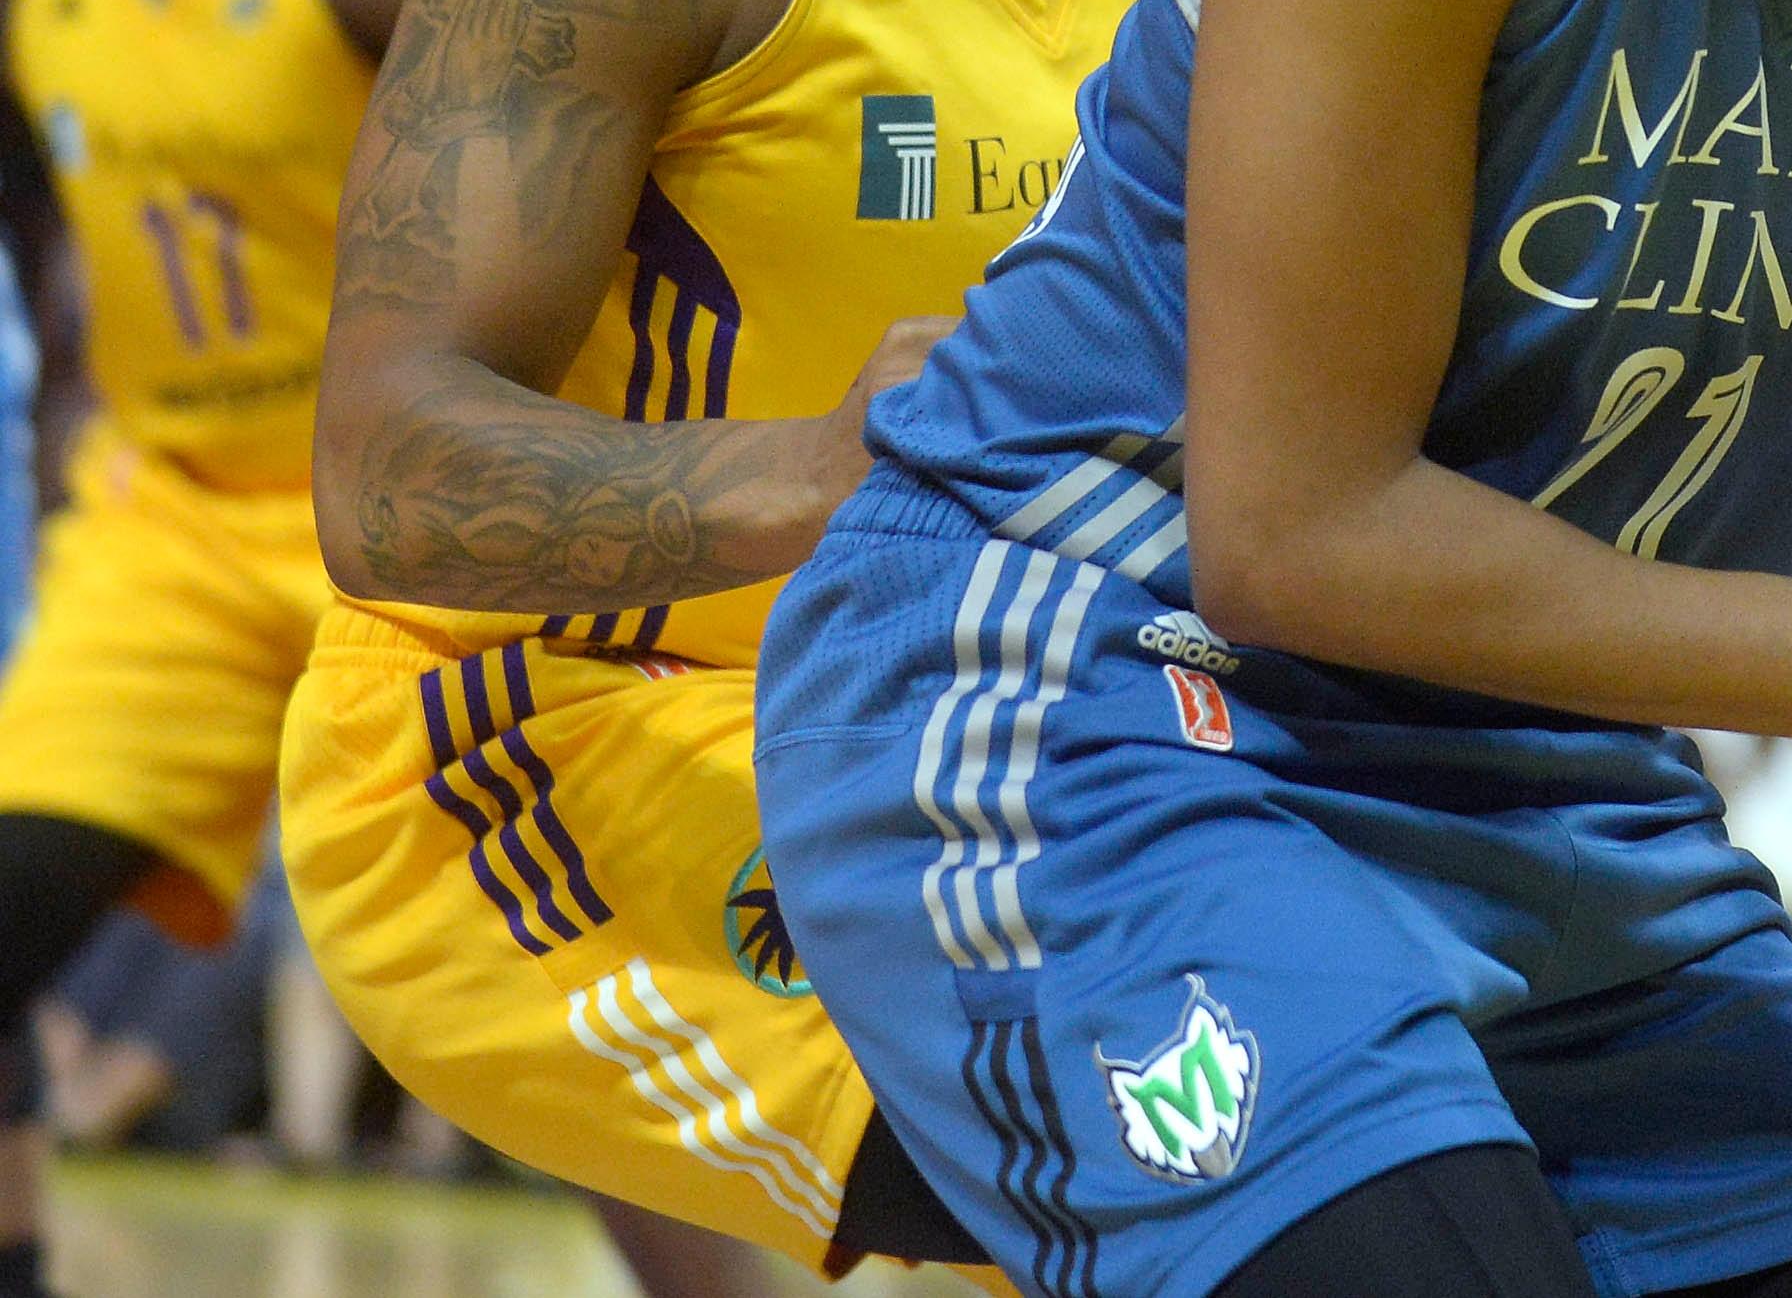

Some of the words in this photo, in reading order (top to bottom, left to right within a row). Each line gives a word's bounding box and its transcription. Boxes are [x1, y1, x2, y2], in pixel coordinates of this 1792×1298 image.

[964, 136, 1064, 215] Eq
[1530, 346, 1765, 564] 21
[1137, 623, 1241, 675] adidas
